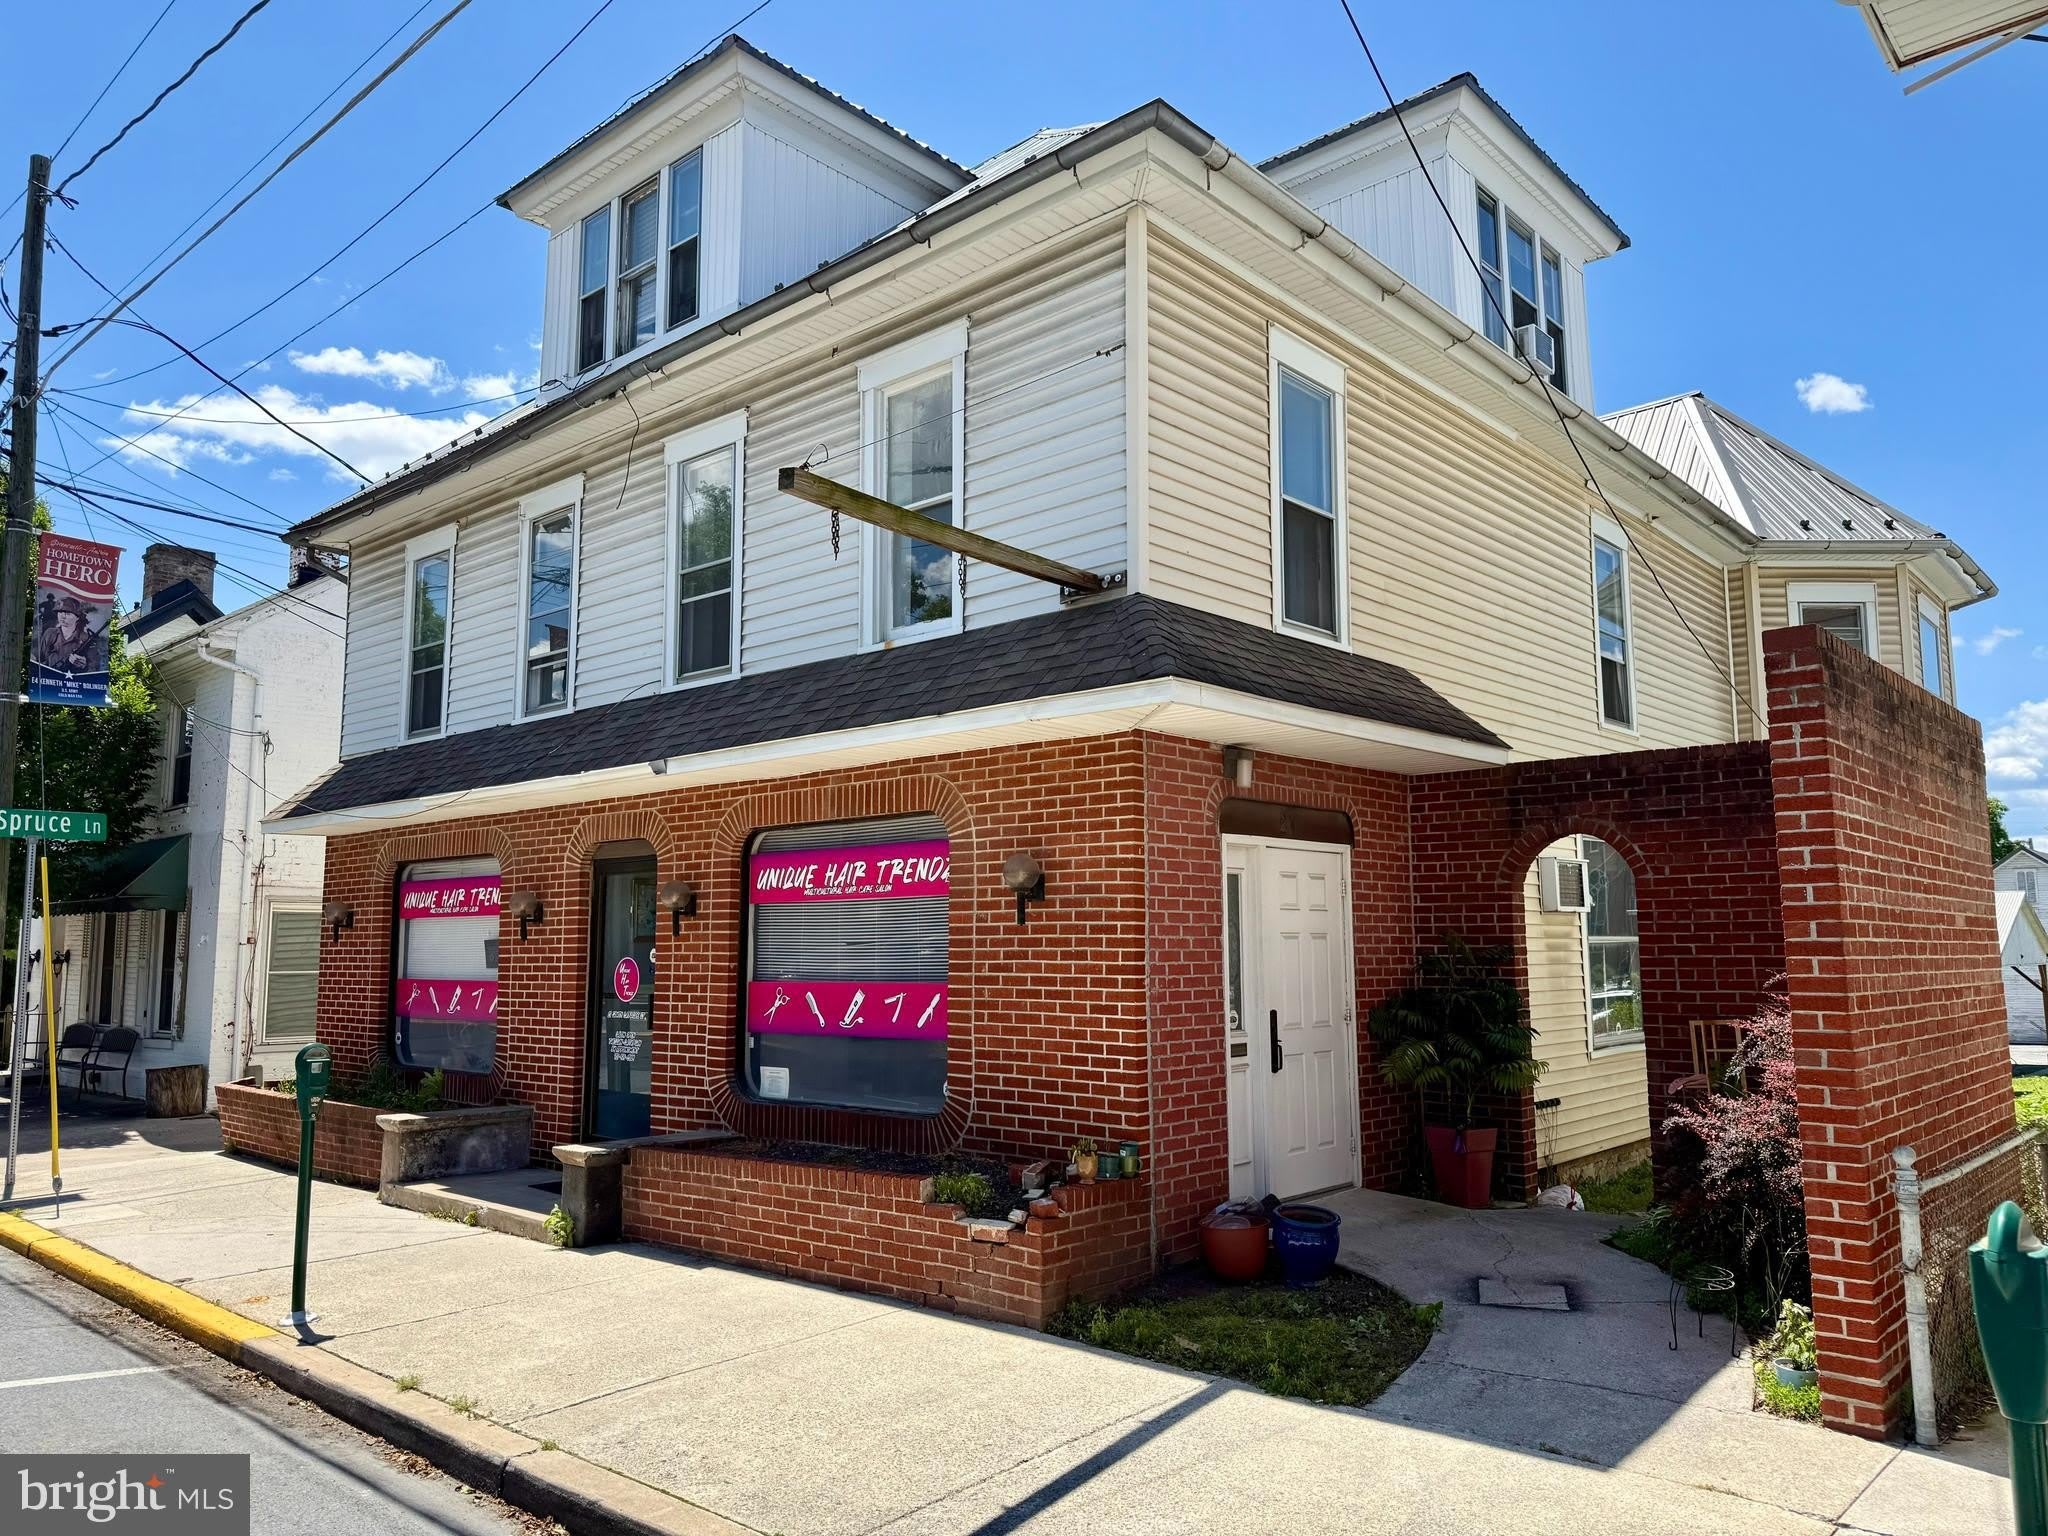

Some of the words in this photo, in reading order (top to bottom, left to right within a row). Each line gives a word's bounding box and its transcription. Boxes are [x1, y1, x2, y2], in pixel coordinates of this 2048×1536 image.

[46, 547, 112, 568] HOMETOWN
[43, 558, 112, 586] HERO
[39, 677, 63, 687] KENNETH
[0, 810, 71, 836] Spruce
[85, 818, 101, 834] Ln
[756, 863, 818, 891] UNIQUE
[825, 861, 866, 888] HAIR
[403, 890, 438, 909] UNIQUE
[441, 888, 466, 907] HAIR
[859, 885, 873, 893] CARE
[875, 884, 893, 893] SALON
